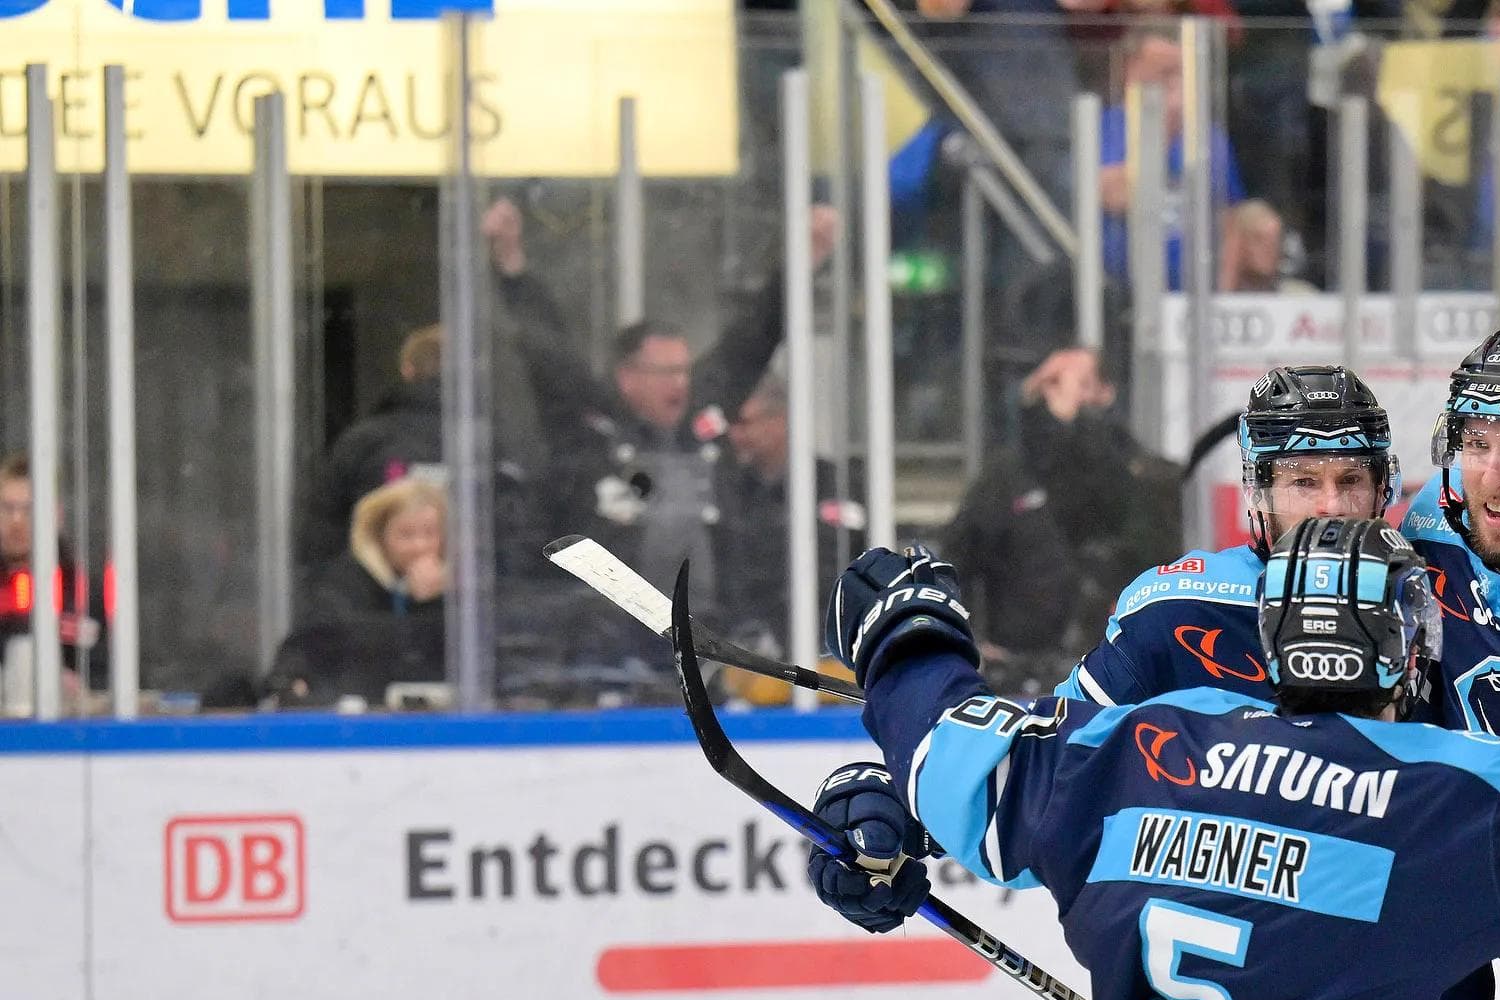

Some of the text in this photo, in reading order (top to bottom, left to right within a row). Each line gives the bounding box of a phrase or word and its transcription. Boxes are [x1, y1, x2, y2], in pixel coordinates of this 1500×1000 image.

[172, 71, 502, 142] VORAUS
[1125, 577, 1252, 613] Regio Bayern
[1313, 565, 1331, 589] 5
[1302, 619, 1338, 631] ERC
[1199, 742, 1398, 818] SATURN
[182, 833, 289, 904] DB
[1128, 812, 1311, 904] WAGNER
